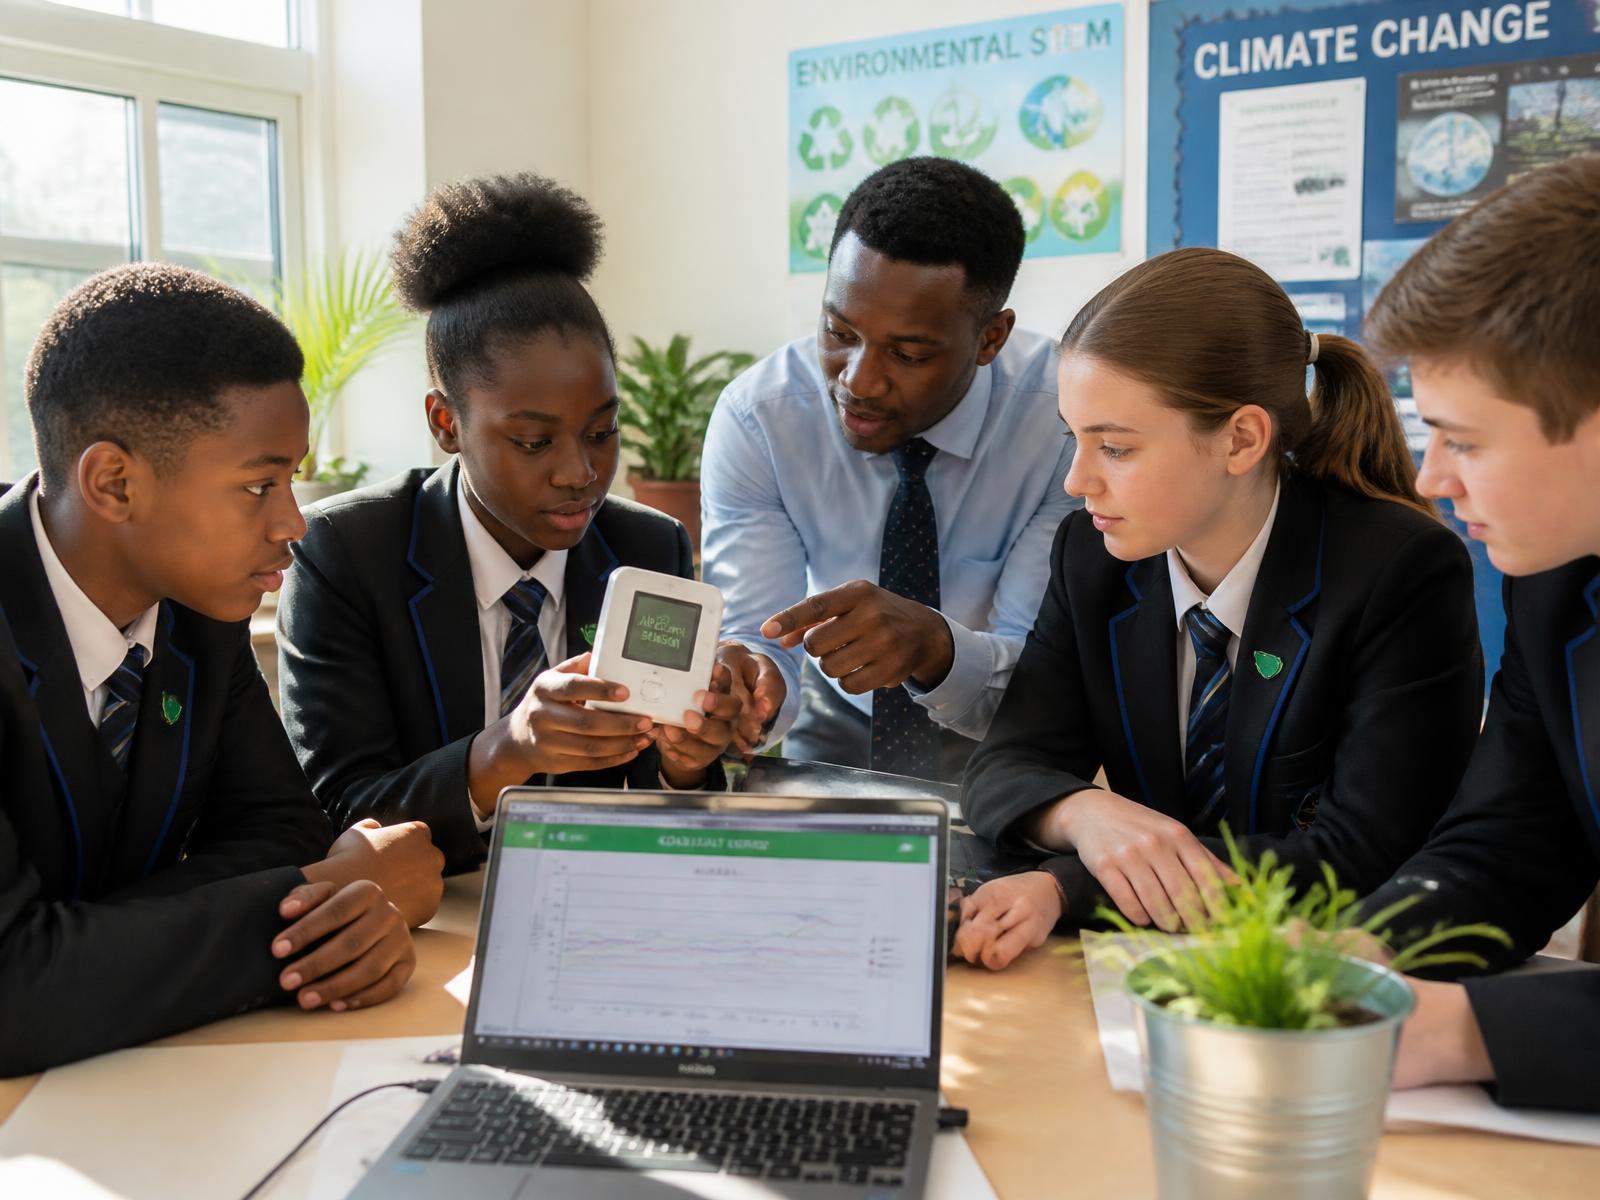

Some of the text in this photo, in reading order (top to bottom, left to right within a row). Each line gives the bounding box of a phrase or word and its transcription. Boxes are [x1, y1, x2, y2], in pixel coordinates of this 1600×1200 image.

[797, 31, 1021, 87] ENVIRONMENTAL
[1194, 1, 1551, 80] CLIMATE CHANGE
